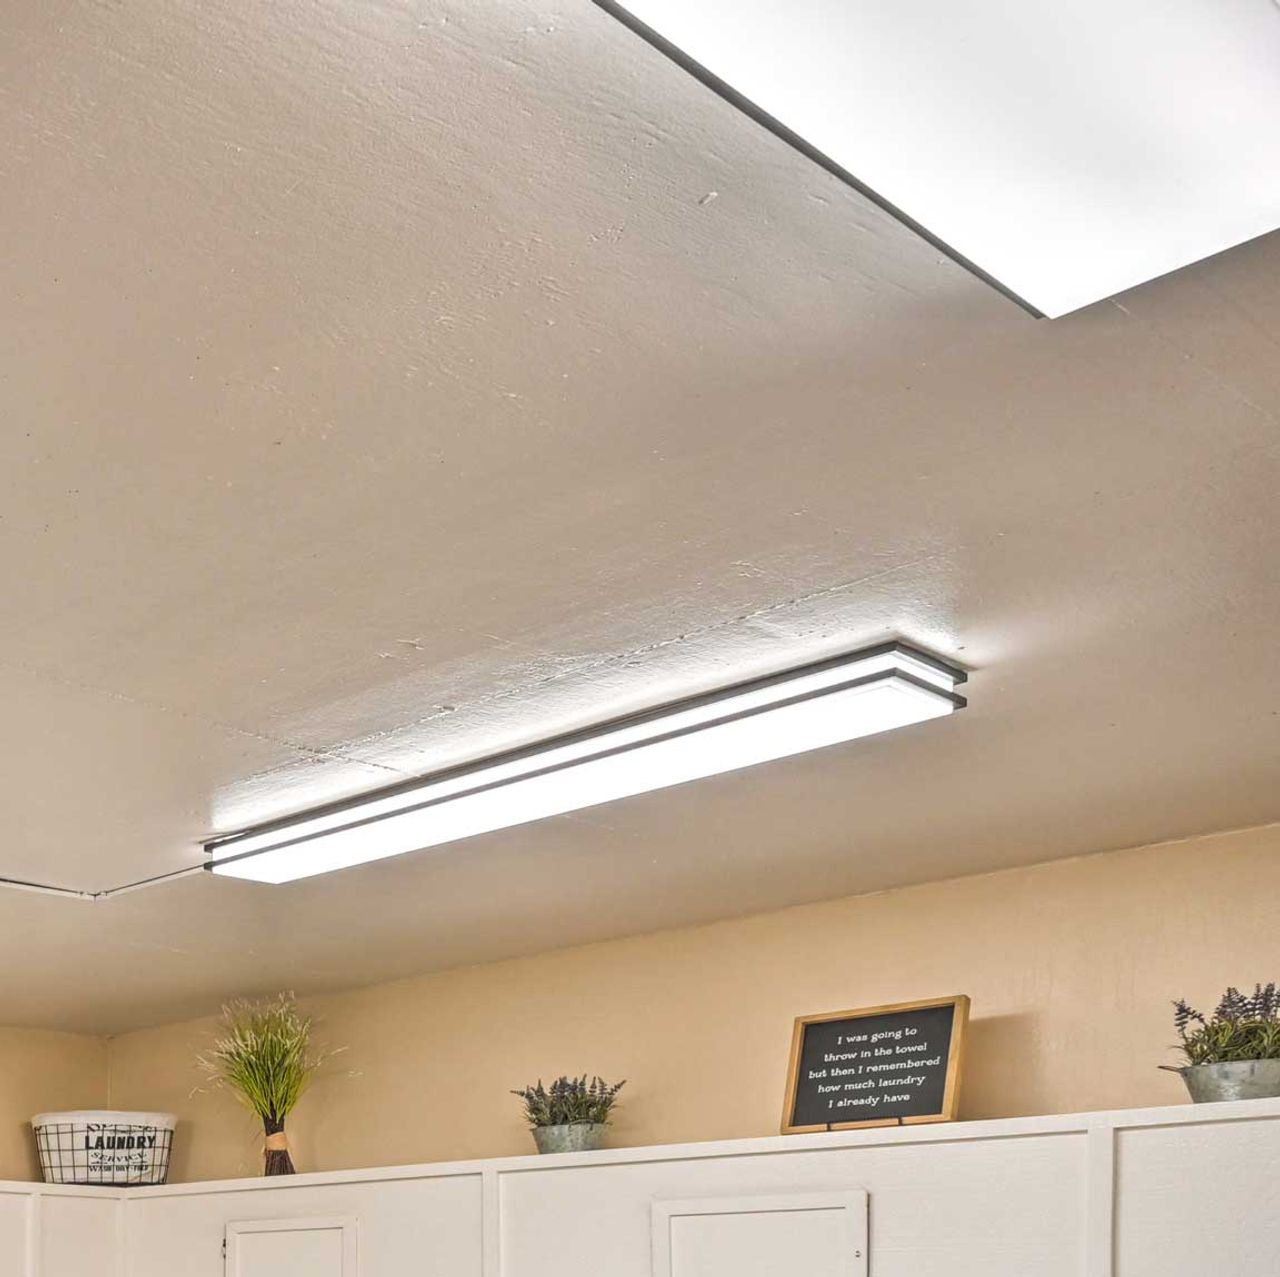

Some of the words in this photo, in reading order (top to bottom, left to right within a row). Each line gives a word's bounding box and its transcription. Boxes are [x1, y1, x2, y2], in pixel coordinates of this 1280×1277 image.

[837, 1036, 842, 1045] I
[846, 1034, 868, 1043] was
[870, 1029, 902, 1043] going
[905, 1027, 918, 1036] to
[824, 1051, 857, 1062] throw
[860, 1050, 871, 1058] in
[874, 1047, 893, 1056] the
[895, 1042, 927, 1055] towel
[808, 1069, 827, 1079] but
[831, 1067, 855, 1077] then
[858, 1065, 863, 1074] I
[866, 1056, 941, 1073] remembered
[818, 1084, 841, 1093] how
[844, 1079, 875, 1091] much
[878, 1075, 926, 1087] laundry
[828, 1099, 833, 1109] I
[837, 1095, 880, 1107] already
[883, 1093, 911, 1103] have
[85, 1135, 156, 1150] LAUNDRY
